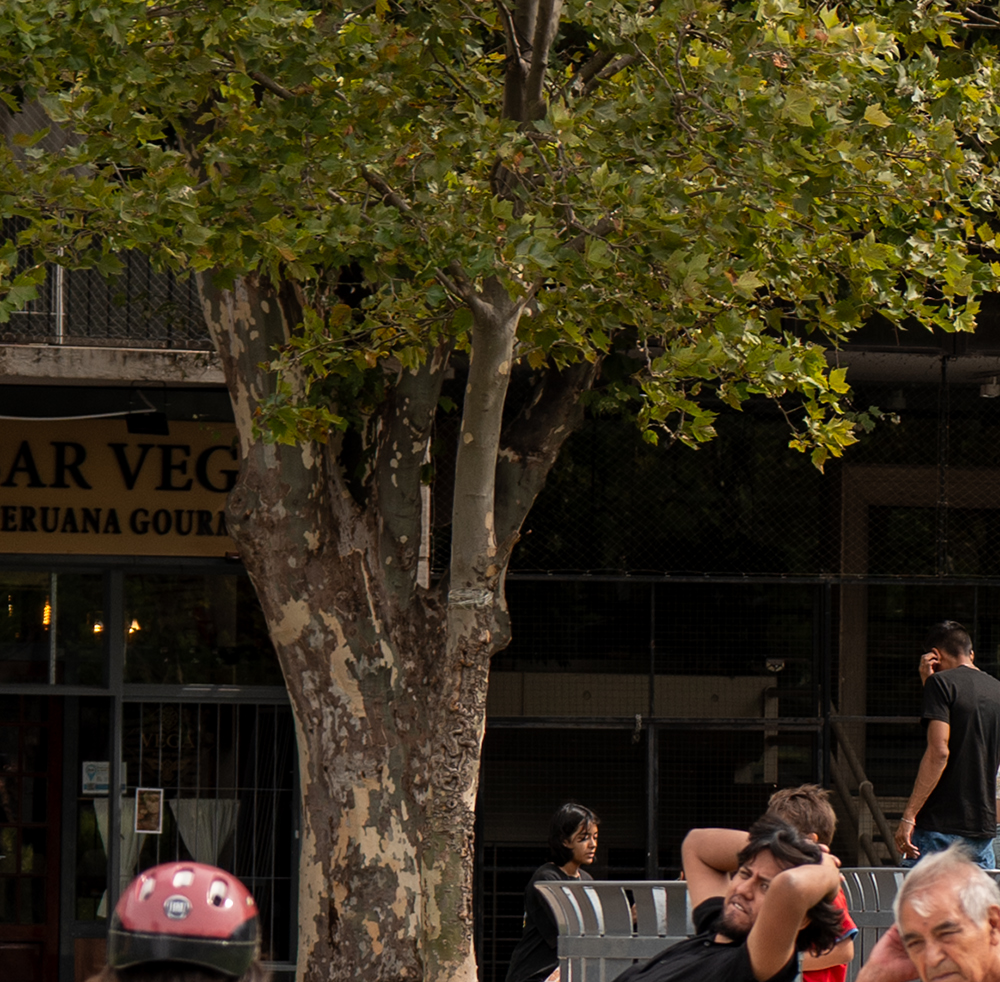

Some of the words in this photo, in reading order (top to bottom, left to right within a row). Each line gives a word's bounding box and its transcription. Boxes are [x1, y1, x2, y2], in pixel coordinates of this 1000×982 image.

[0, 440, 92, 490] AR
[107, 442, 238, 493] VEG
[0, 505, 121, 534] ERUANA
